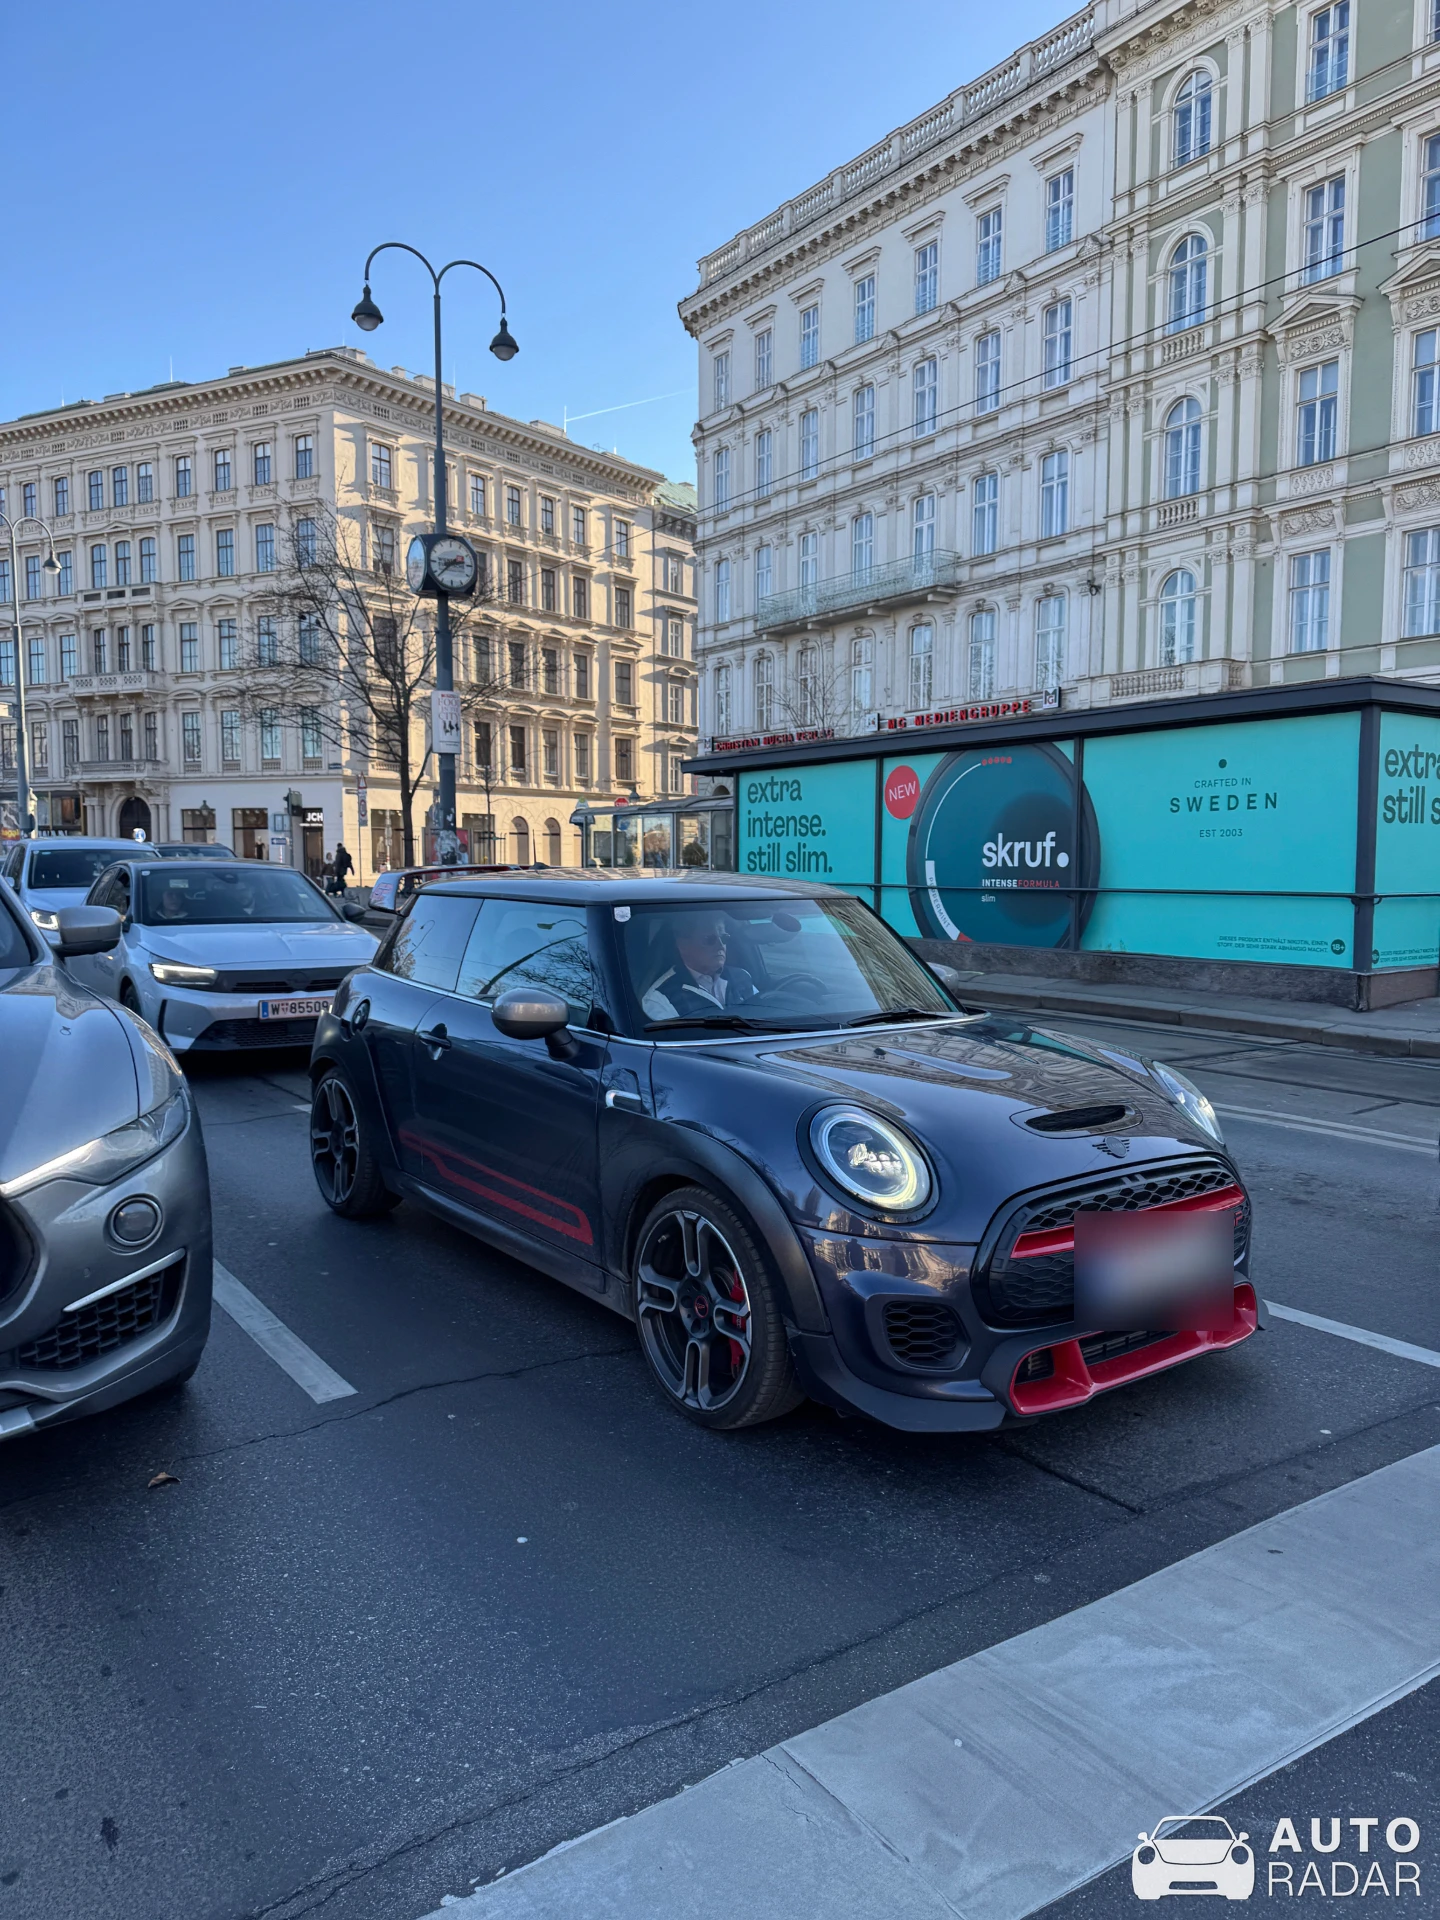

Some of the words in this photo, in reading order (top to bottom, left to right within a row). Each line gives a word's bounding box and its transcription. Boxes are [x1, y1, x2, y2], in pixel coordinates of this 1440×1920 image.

[887, 717, 906, 729] MG
[914, 700, 1031, 726] MEDIENGRUPPE
[715, 738, 759, 751] CHRISTIAN
[747, 776, 802, 804] extra
[889, 780, 916, 802] NEW
[1194, 778, 1238, 788] CRAFTED
[1241, 777, 1252, 786] IN
[1169, 792, 1277, 813] SWEDEN
[1383, 786, 1425, 824] still
[306, 812, 323, 821] JCH
[747, 809, 826, 837] intense.
[1199, 829, 1217, 837] EST
[1220, 828, 1243, 837] 2003
[747, 842, 780, 872] still
[786, 842, 833, 873] slim.
[982, 831, 1069, 868] skruf.
[981, 894, 996, 902] slim
[1331, 943, 1345, 951] 18+
[271, 1003, 280, 1015] W
